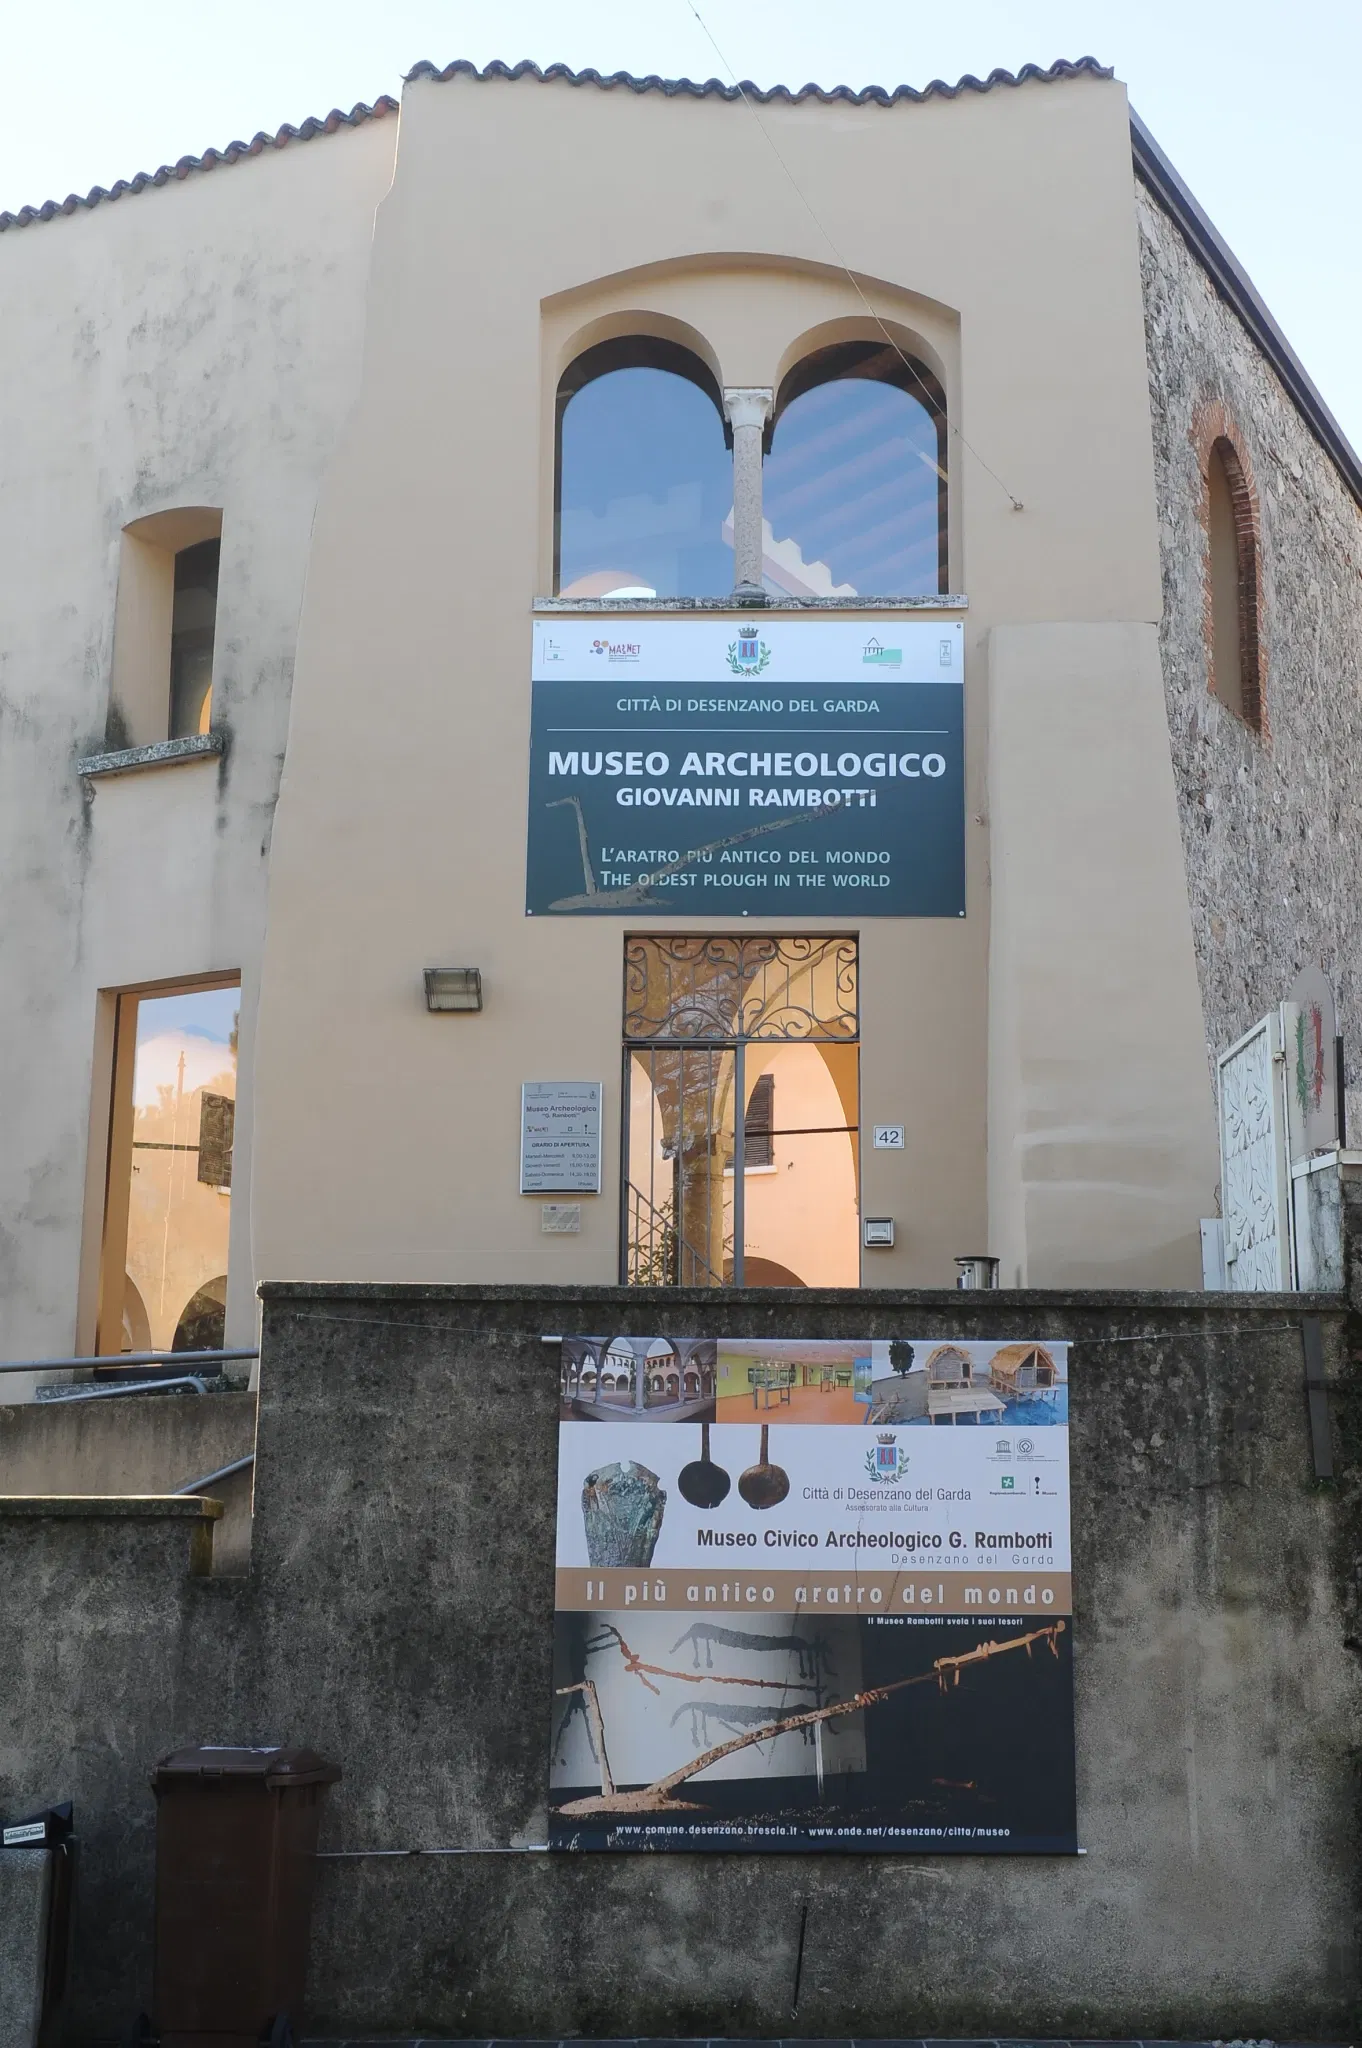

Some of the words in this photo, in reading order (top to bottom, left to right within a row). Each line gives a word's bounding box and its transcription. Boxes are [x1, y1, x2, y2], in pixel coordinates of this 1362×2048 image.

[616, 695, 661, 712] CITTÀ
[665, 698, 682, 712] DI
[687, 698, 784, 713] DESENZANO
[789, 699, 818, 713] DEL
[823, 699, 880, 713] GARDA
[548, 751, 670, 776] MUSEO
[680, 752, 947, 778] ARCHEOLOGICO
[616, 788, 740, 807] GIOVANNI
[749, 788, 877, 808] RAMBOTTI
[601, 847, 679, 864] L'ARATRO
[687, 847, 713, 864] PIÙ
[720, 850, 782, 865] ANTICO
[789, 850, 819, 865] DEL
[826, 850, 891, 865] MONDO
[600, 870, 631, 887] THE
[638, 872, 698, 887] OLDEST
[703, 872, 767, 888] PLOUGH
[774, 873, 790, 887] IN
[796, 873, 826, 888] THE
[832, 873, 891, 888] WORLD
[550, 1105, 597, 1113] Archeologico
[879, 1130, 899, 1144] 42
[802, 1487, 829, 1500] Città
[833, 1487, 844, 1500] di
[847, 1488, 912, 1500] Desenzano
[916, 1488, 933, 1500] del
[936, 1488, 972, 1501] Garda
[845, 1504, 888, 1512] Assessorato
[890, 1503, 902, 1512] alla
[903, 1504, 929, 1512] Cultura
[697, 1530, 757, 1546] Museo
[764, 1530, 819, 1547] Civico
[825, 1531, 942, 1551] Archeologico
[948, 1532, 967, 1549] G.
[974, 1532, 1053, 1549] Rambotti
[891, 1554, 969, 1564] Desenzano
[977, 1554, 998, 1564] del
[1012, 1555, 1054, 1565] Garda
[586, 1581, 605, 1600] Il
[624, 1579, 667, 1605] più
[687, 1584, 775, 1603] antico
[795, 1585, 883, 1603] aratro
[902, 1584, 944, 1604] del
[964, 1584, 1055, 1605] mondo
[867, 1617, 874, 1625] Il
[877, 1617, 904, 1625] Museo
[907, 1617, 944, 1625] Rambotti
[946, 1617, 970, 1625] svela
[977, 1617, 996, 1626] suoi
[998, 1617, 1023, 1626] tesori
[616, 1825, 797, 1836] www.comune.desenzano.brescia.it
[808, 1826, 1011, 1838] www.onde.net/desenzano/citta/museo
